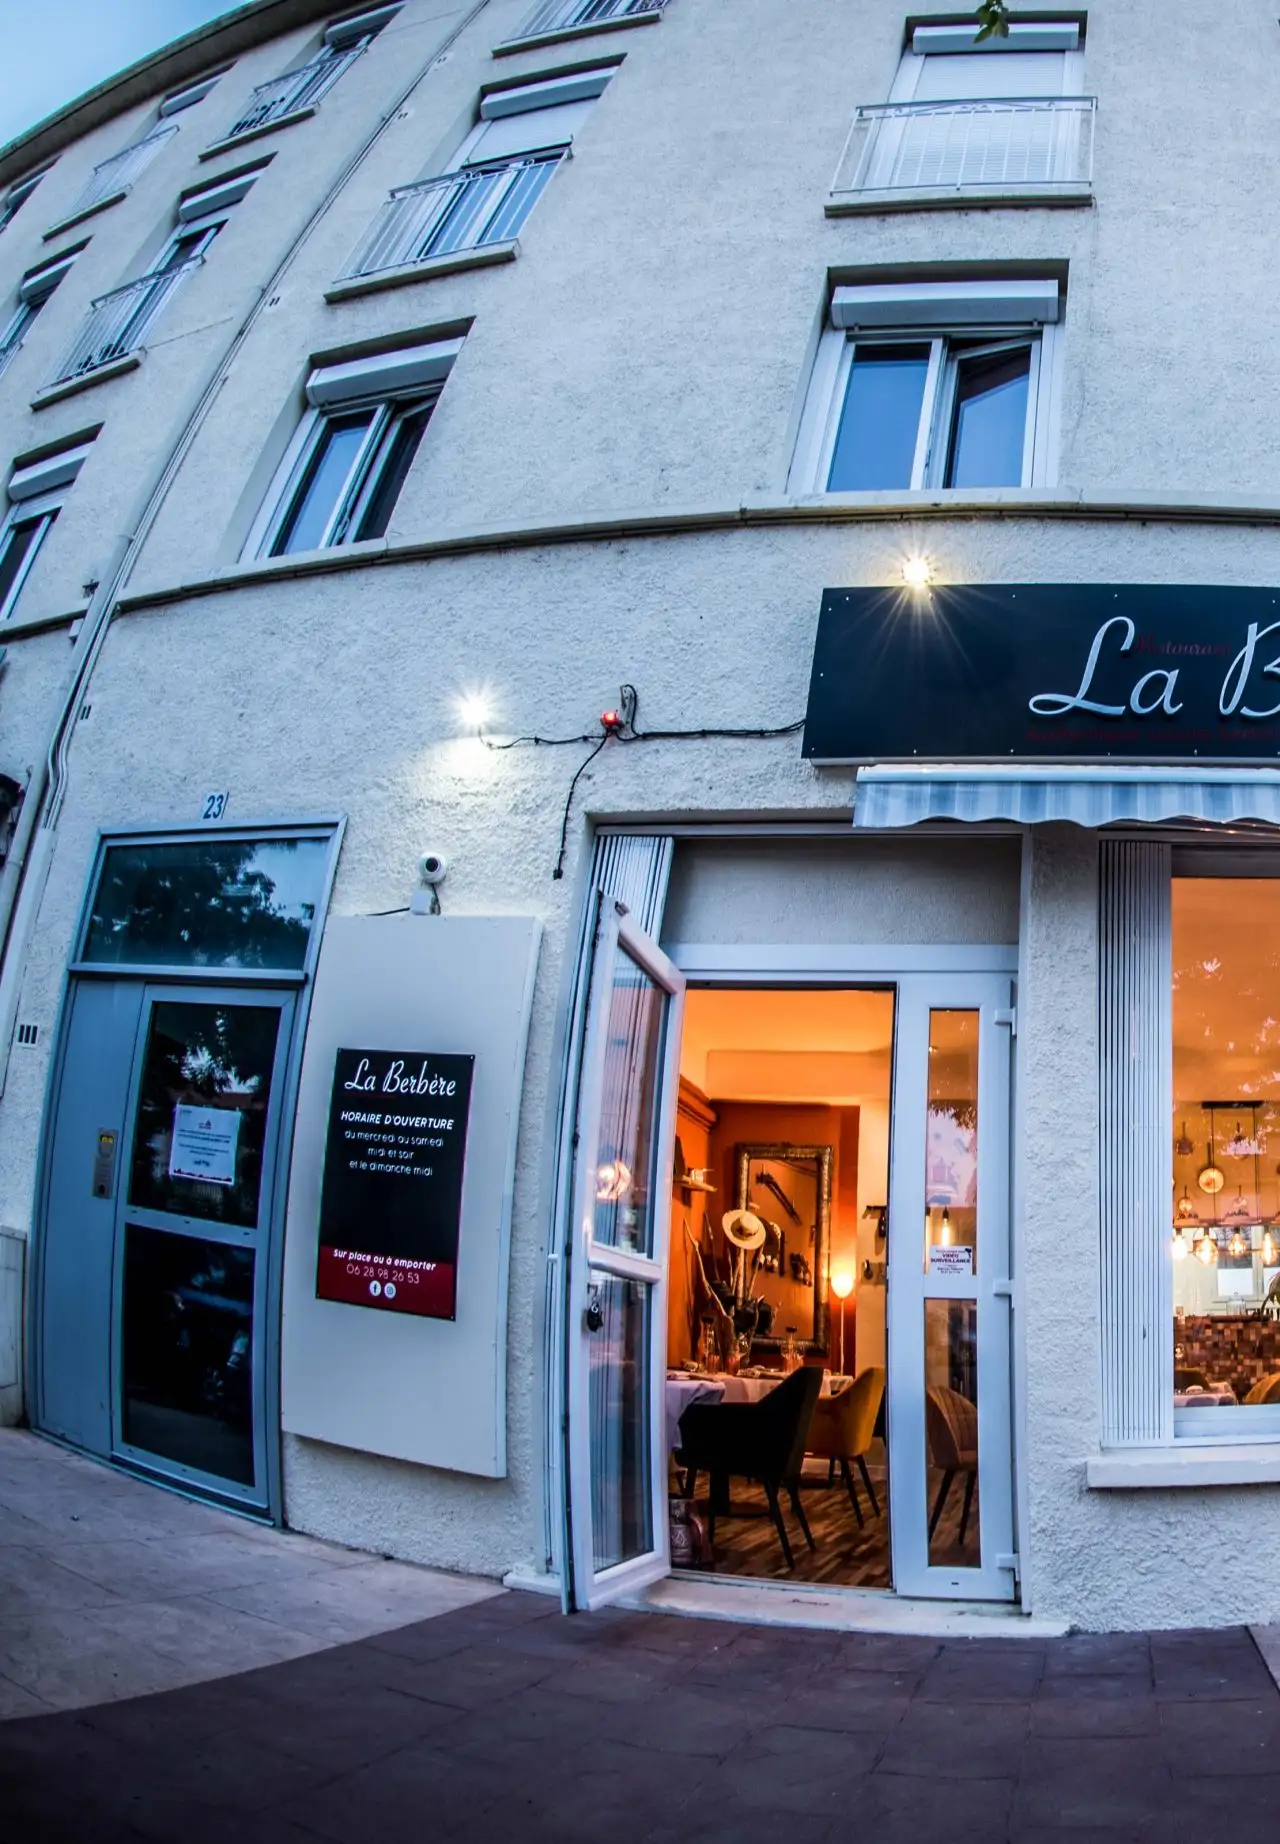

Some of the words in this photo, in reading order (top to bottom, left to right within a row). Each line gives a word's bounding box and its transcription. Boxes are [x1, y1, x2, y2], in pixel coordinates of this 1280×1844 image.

[1028, 615, 1182, 717] La
[203, 794, 224, 820] 23
[344, 1058, 376, 1091] La
[382, 1060, 456, 1096] Berbère
[341, 1111, 382, 1124] HORAIRE
[384, 1114, 454, 1130] D'OUVERTURE
[345, 1130, 355, 1139] du
[357, 1132, 395, 1143] mercredi
[398, 1135, 409, 1144] au
[411, 1136, 444, 1147] samedi
[368, 1147, 385, 1157] midi
[388, 1149, 396, 1158] et
[399, 1150, 414, 1159] soir
[349, 1160, 358, 1169] et
[369, 1162, 411, 1174] dimanche
[413, 1166, 433, 1176] midi
[333, 1248, 347, 1259] sur
[348, 1251, 371, 1263] place
[373, 1255, 384, 1264] ou
[394, 1259, 437, 1272] emporter
[346, 1263, 361, 1276] 06
[363, 1266, 375, 1277] 28
[377, 1268, 389, 1279] 98
[392, 1270, 404, 1282] 26
[407, 1272, 420, 1284] 53
